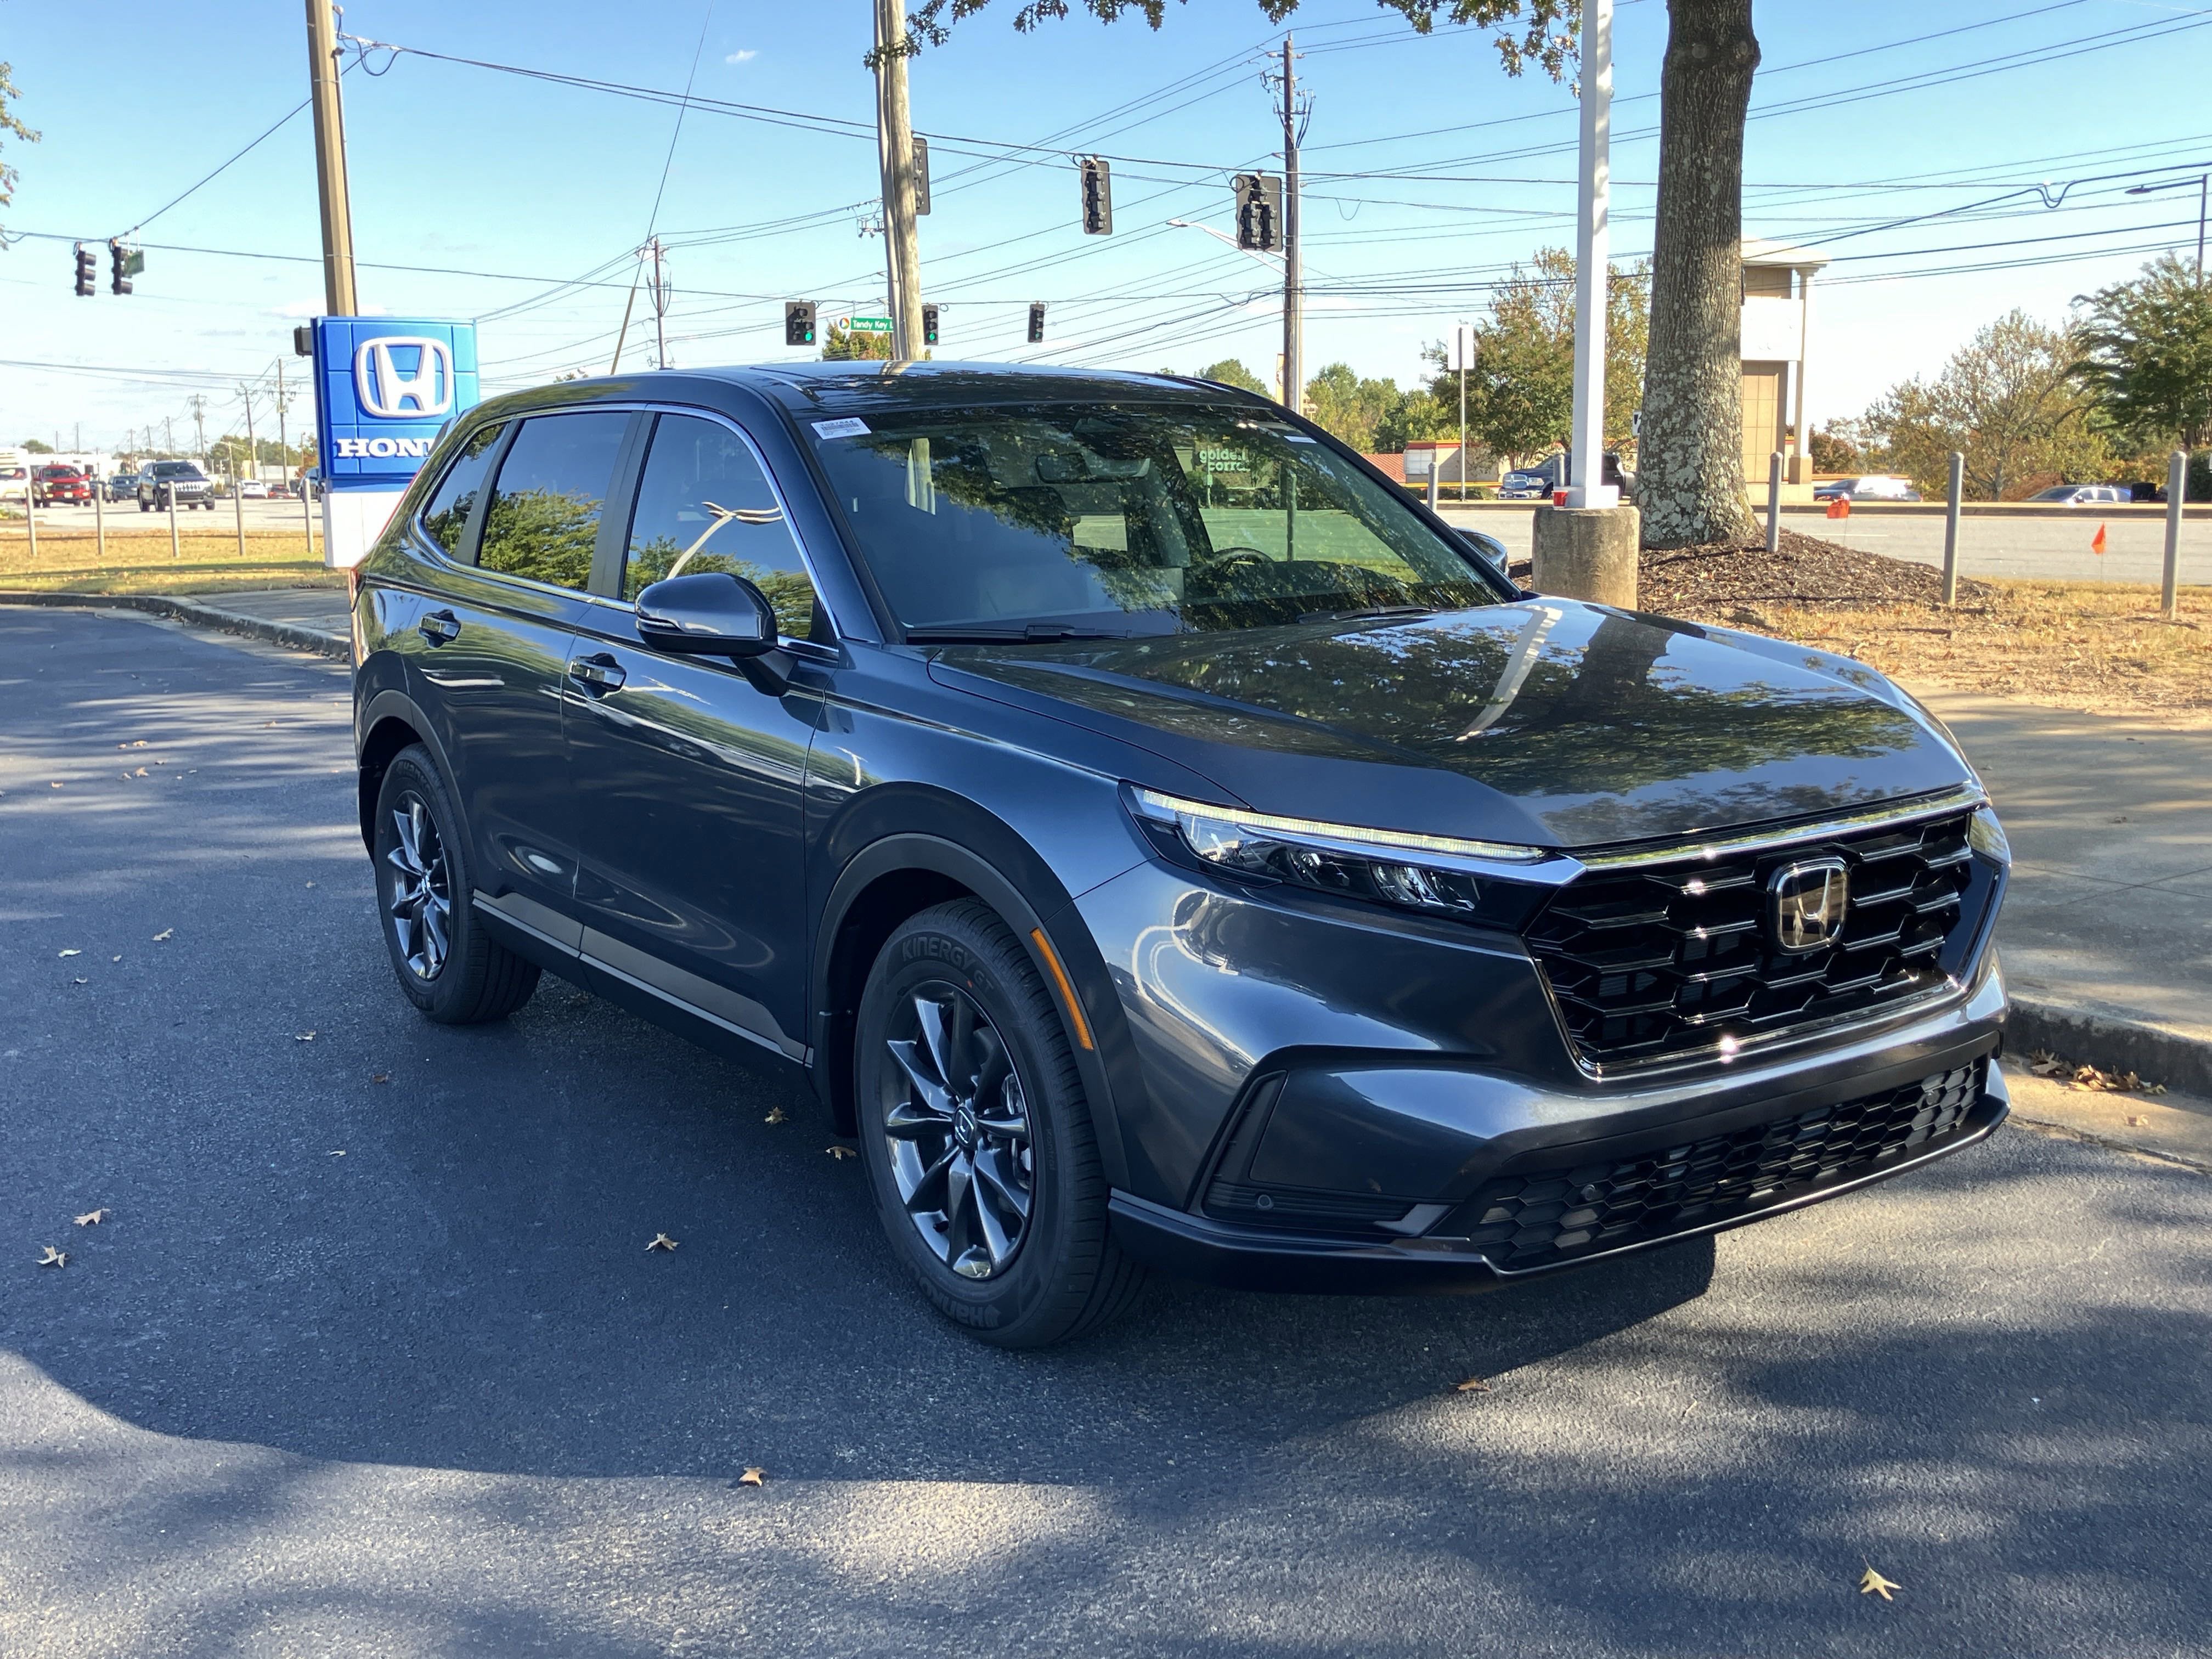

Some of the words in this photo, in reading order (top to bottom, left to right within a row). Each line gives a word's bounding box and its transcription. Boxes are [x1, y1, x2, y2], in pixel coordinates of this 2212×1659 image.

[853, 320, 873, 330] Tandy
[874, 320, 888, 330] Key
[337, 438, 435, 457] HON
[901, 936, 977, 970] KINERGY
[974, 969, 994, 992] GT
